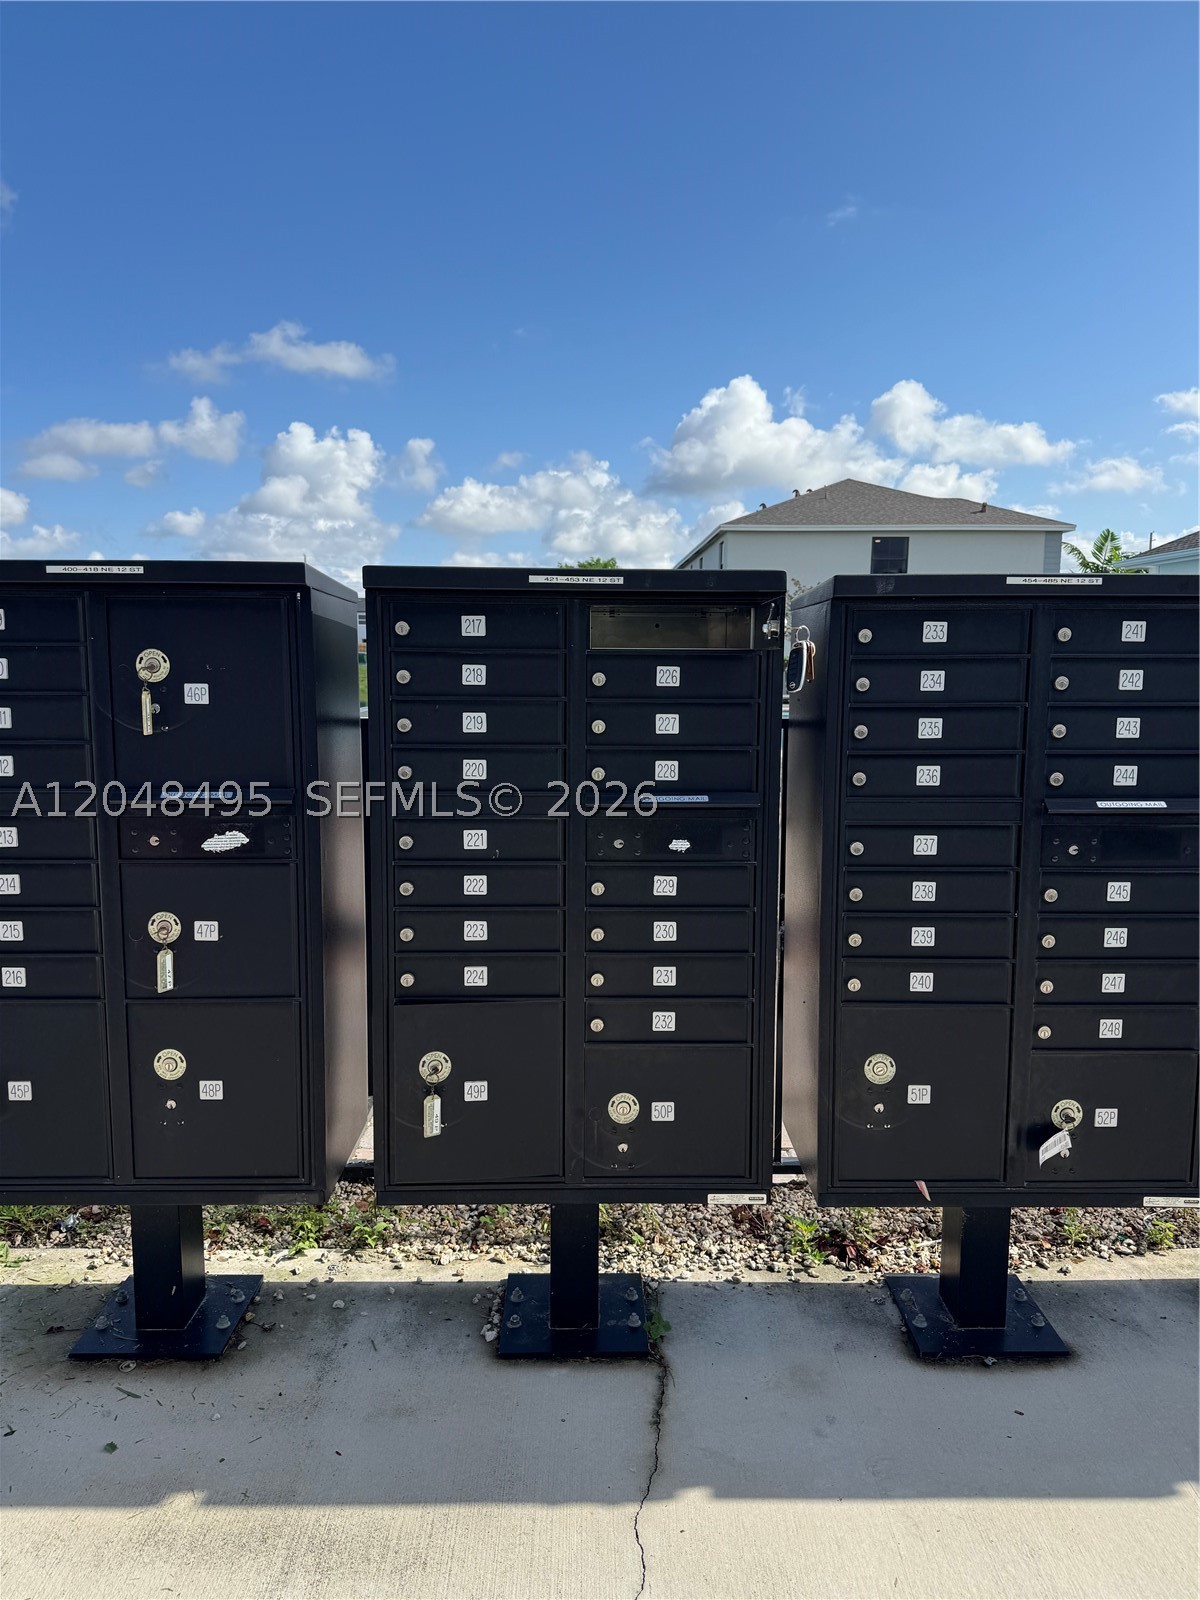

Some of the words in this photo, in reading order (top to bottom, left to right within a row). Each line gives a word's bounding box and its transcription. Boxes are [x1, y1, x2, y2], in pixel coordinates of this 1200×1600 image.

[464, 618, 482, 634] 217
[924, 623, 945, 641] 233
[1124, 623, 1144, 640] 241
[464, 667, 484, 684] 218
[658, 668, 678, 685] 226
[921, 673, 942, 689] 234
[1121, 672, 1141, 688] 242
[186, 686, 207, 702] 46P
[465, 714, 484, 731] 219
[657, 716, 677, 732] 227
[920, 721, 941, 737] 235
[1117, 720, 1139, 736] 243
[464, 761, 485, 777] 220
[656, 763, 677, 779] 228
[918, 768, 939, 784] 236
[1114, 768, 1135, 784] 244
[466, 832, 484, 848] 221
[915, 837, 936, 853] 237
[465, 877, 485, 893] 222
[655, 878, 675, 894] 229
[913, 884, 934, 900] 238
[1108, 884, 1129, 900] 245
[1, 923, 21, 939] 215
[196, 922, 217, 939] 47P
[465, 923, 486, 939] 223
[655, 923, 675, 939] 230
[913, 929, 933, 945] 239
[1105, 930, 1126, 946] 246
[3, 969, 24, 986] 216
[465, 969, 485, 985] 224
[655, 968, 673, 984] 231
[911, 974, 932, 990] 240
[1103, 975, 1124, 991] 247
[654, 1014, 673, 1030] 232
[1100, 1021, 1121, 1037] 248
[9, 1084, 30, 1099] 45P
[201, 1083, 222, 1098] 48P
[466, 1084, 486, 1100] 49P
[910, 1087, 929, 1102] 51P
[653, 1104, 673, 1120] 50P
[1096, 1110, 1116, 1126] 52P
